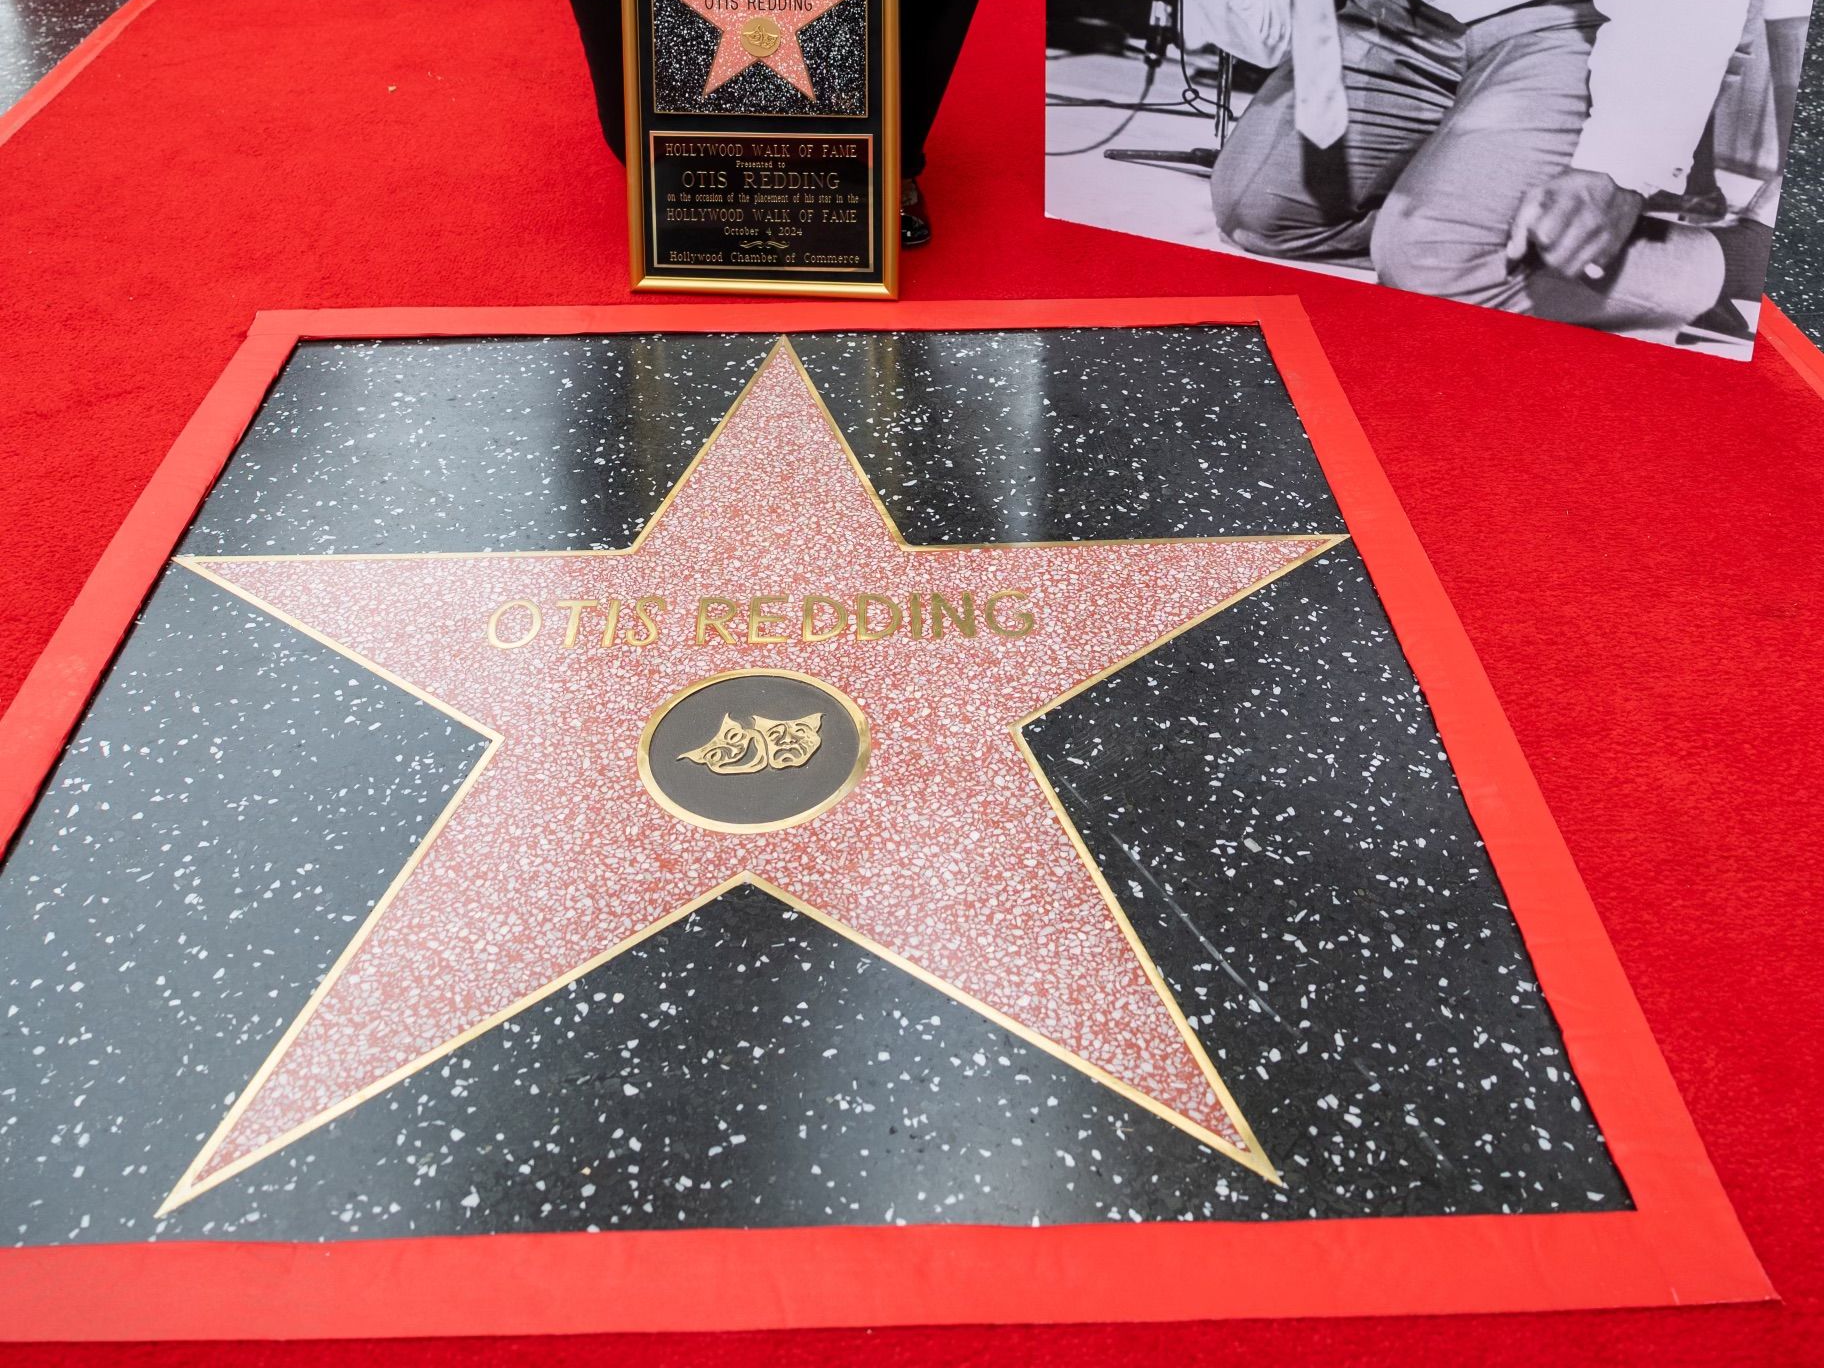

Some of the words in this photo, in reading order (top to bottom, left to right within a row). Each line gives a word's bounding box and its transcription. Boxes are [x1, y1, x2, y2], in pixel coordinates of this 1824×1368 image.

[665, 143, 744, 157] HOLLYWOOD
[751, 144, 791, 158] WALK
[799, 144, 814, 158] OF
[822, 144, 858, 158] FAME
[735, 160, 773, 169] Presented
[778, 161, 786, 169] to
[681, 170, 729, 189] OTIS
[743, 171, 841, 190] REDDING
[667, 194, 676, 202] on
[679, 193, 691, 202] the
[695, 193, 723, 203] occasion
[727, 193, 734, 203] of
[738, 193, 750, 203] the
[754, 193, 789, 205] placement
[792, 193, 800, 204] of
[804, 193, 815, 204] his
[818, 194, 832, 204] star
[836, 193, 844, 204] in
[847, 194, 860, 204] the
[666, 208, 744, 222] HOLLYWOOD
[752, 209, 791, 223] WALK
[799, 209, 814, 223] OF
[822, 209, 858, 223] FAME
[724, 226, 760, 236] October
[766, 226, 772, 236] 4
[778, 226, 803, 236] 2024
[669, 250, 723, 264] Hollywood
[730, 252, 779, 264] Chamber
[785, 252, 796, 264] of
[804, 253, 860, 264] Commerce
[486, 598, 669, 650] OTIS
[695, 589, 1037, 647] REDDING
